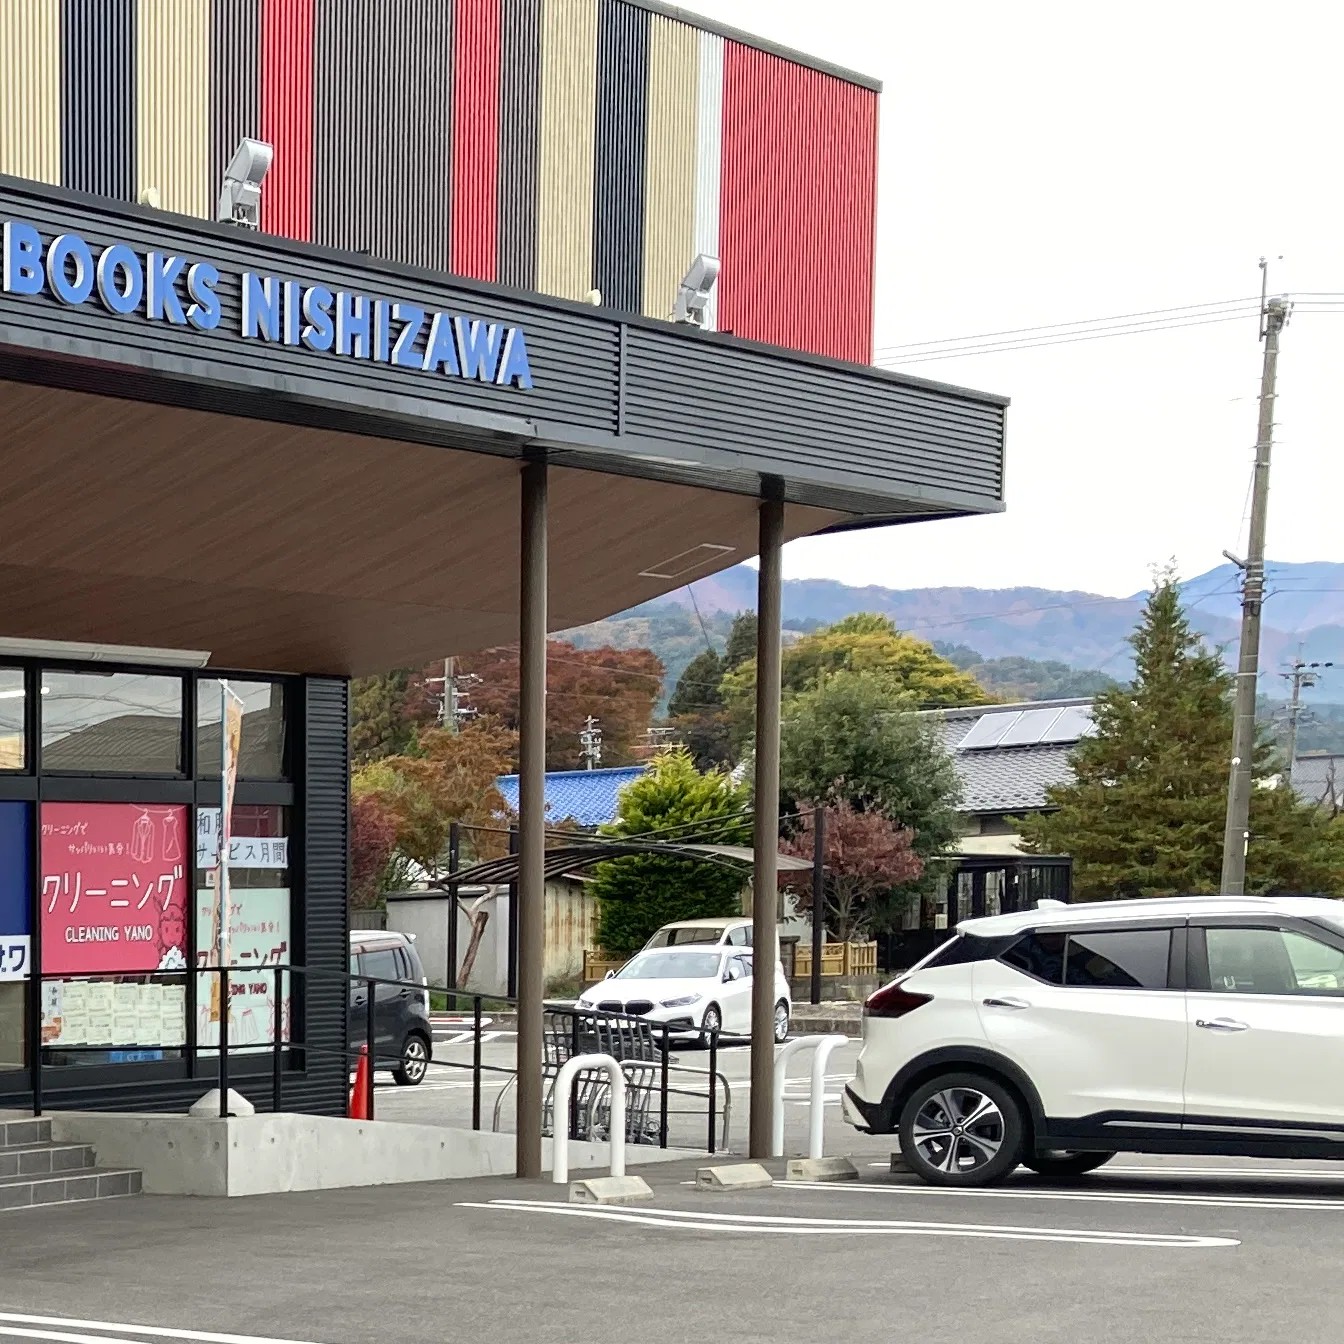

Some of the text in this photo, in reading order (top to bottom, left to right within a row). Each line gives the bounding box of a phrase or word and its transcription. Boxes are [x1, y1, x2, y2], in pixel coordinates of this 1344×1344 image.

[3, 220, 534, 390] BOOKS NISHIZAWA
[41, 821, 89, 836] クリーニングで
[42, 864, 184, 914] クリーニング
[64, 925, 154, 943] CLEANING YANO
